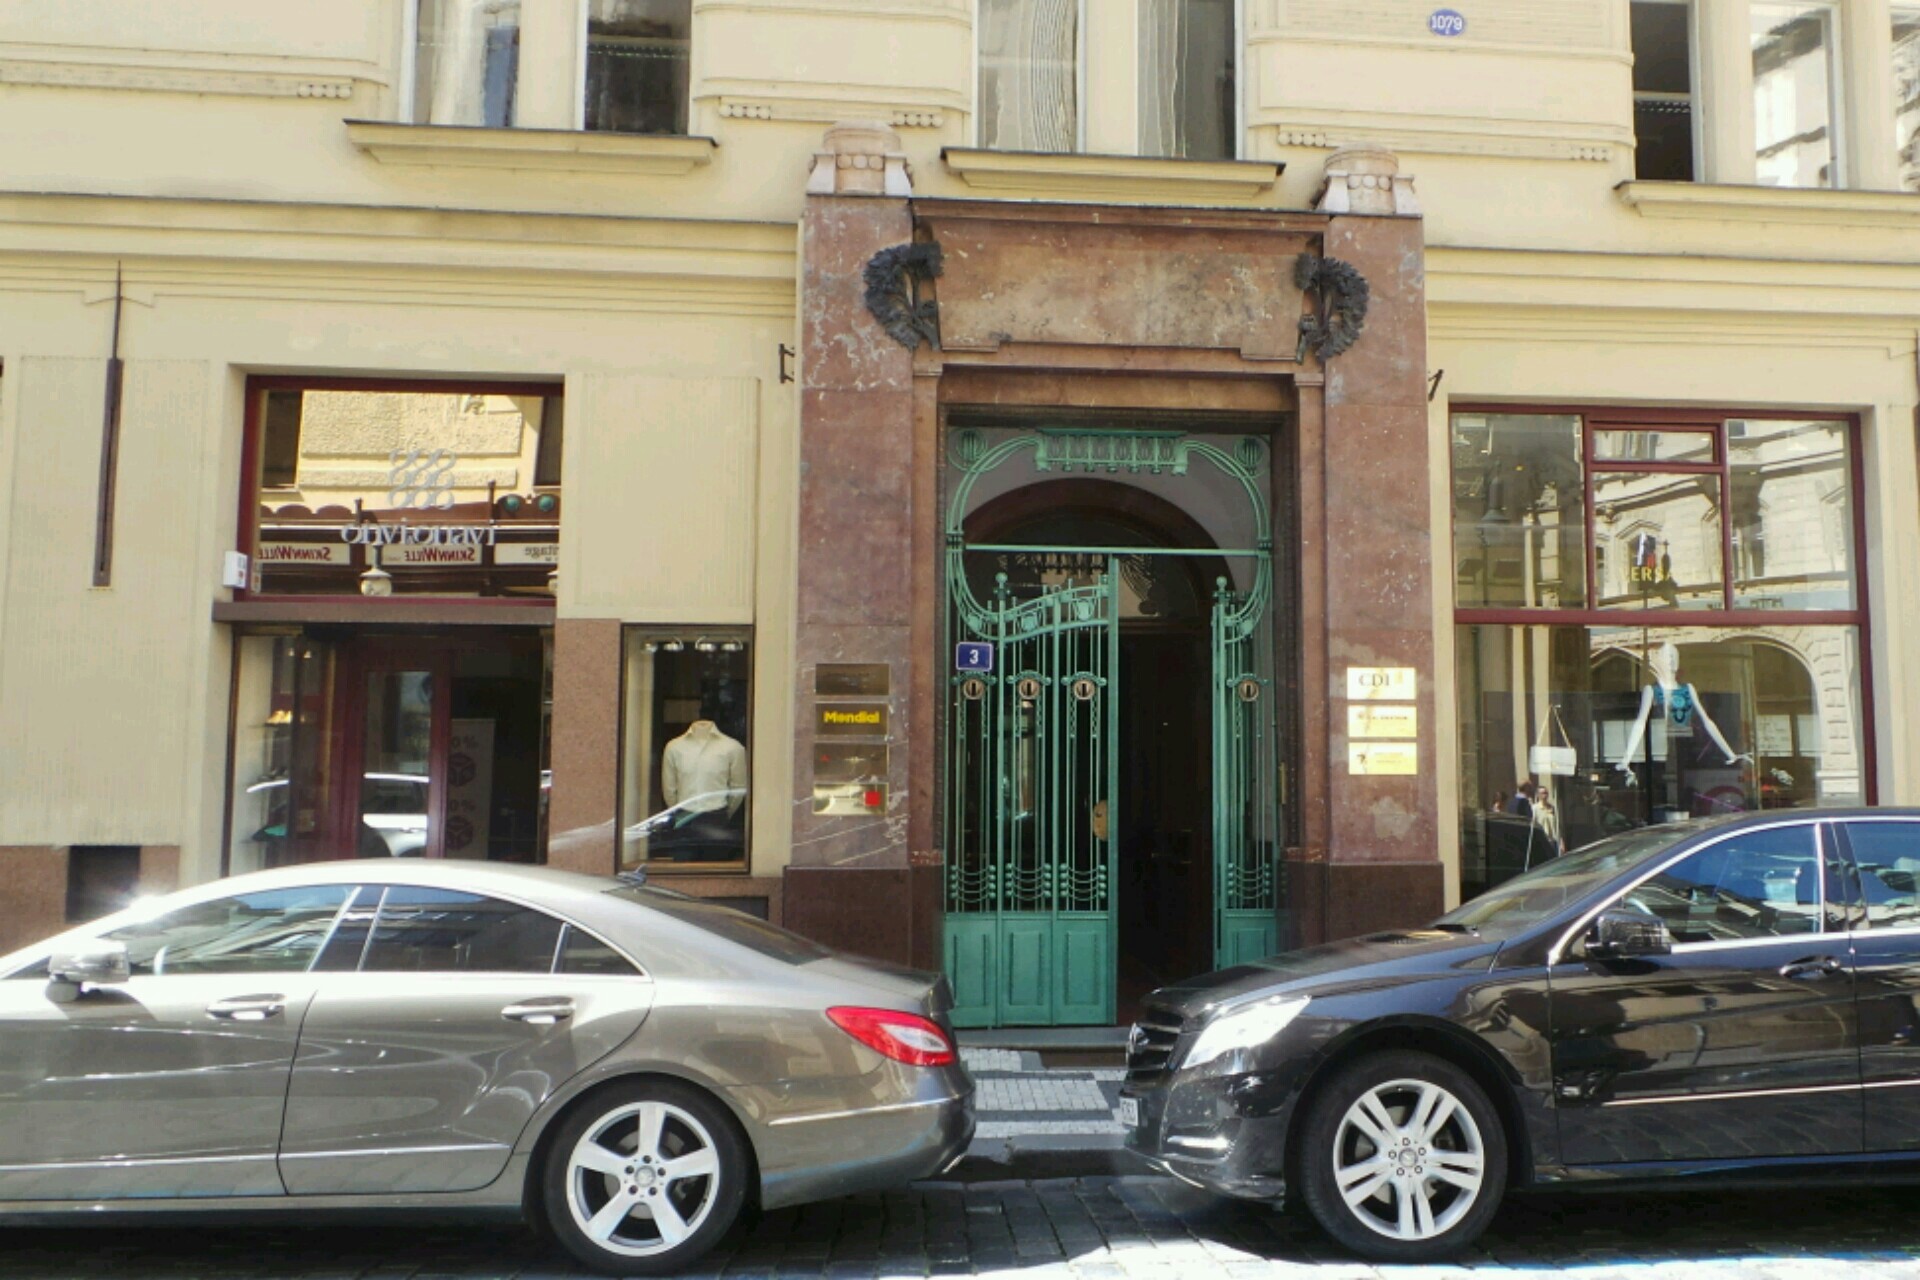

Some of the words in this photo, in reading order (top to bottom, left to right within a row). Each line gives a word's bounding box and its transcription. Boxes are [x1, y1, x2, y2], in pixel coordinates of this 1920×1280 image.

[1430, 15, 1463, 31] 1079
[969, 648, 980, 665] 3
[823, 710, 881, 724] Mondial
